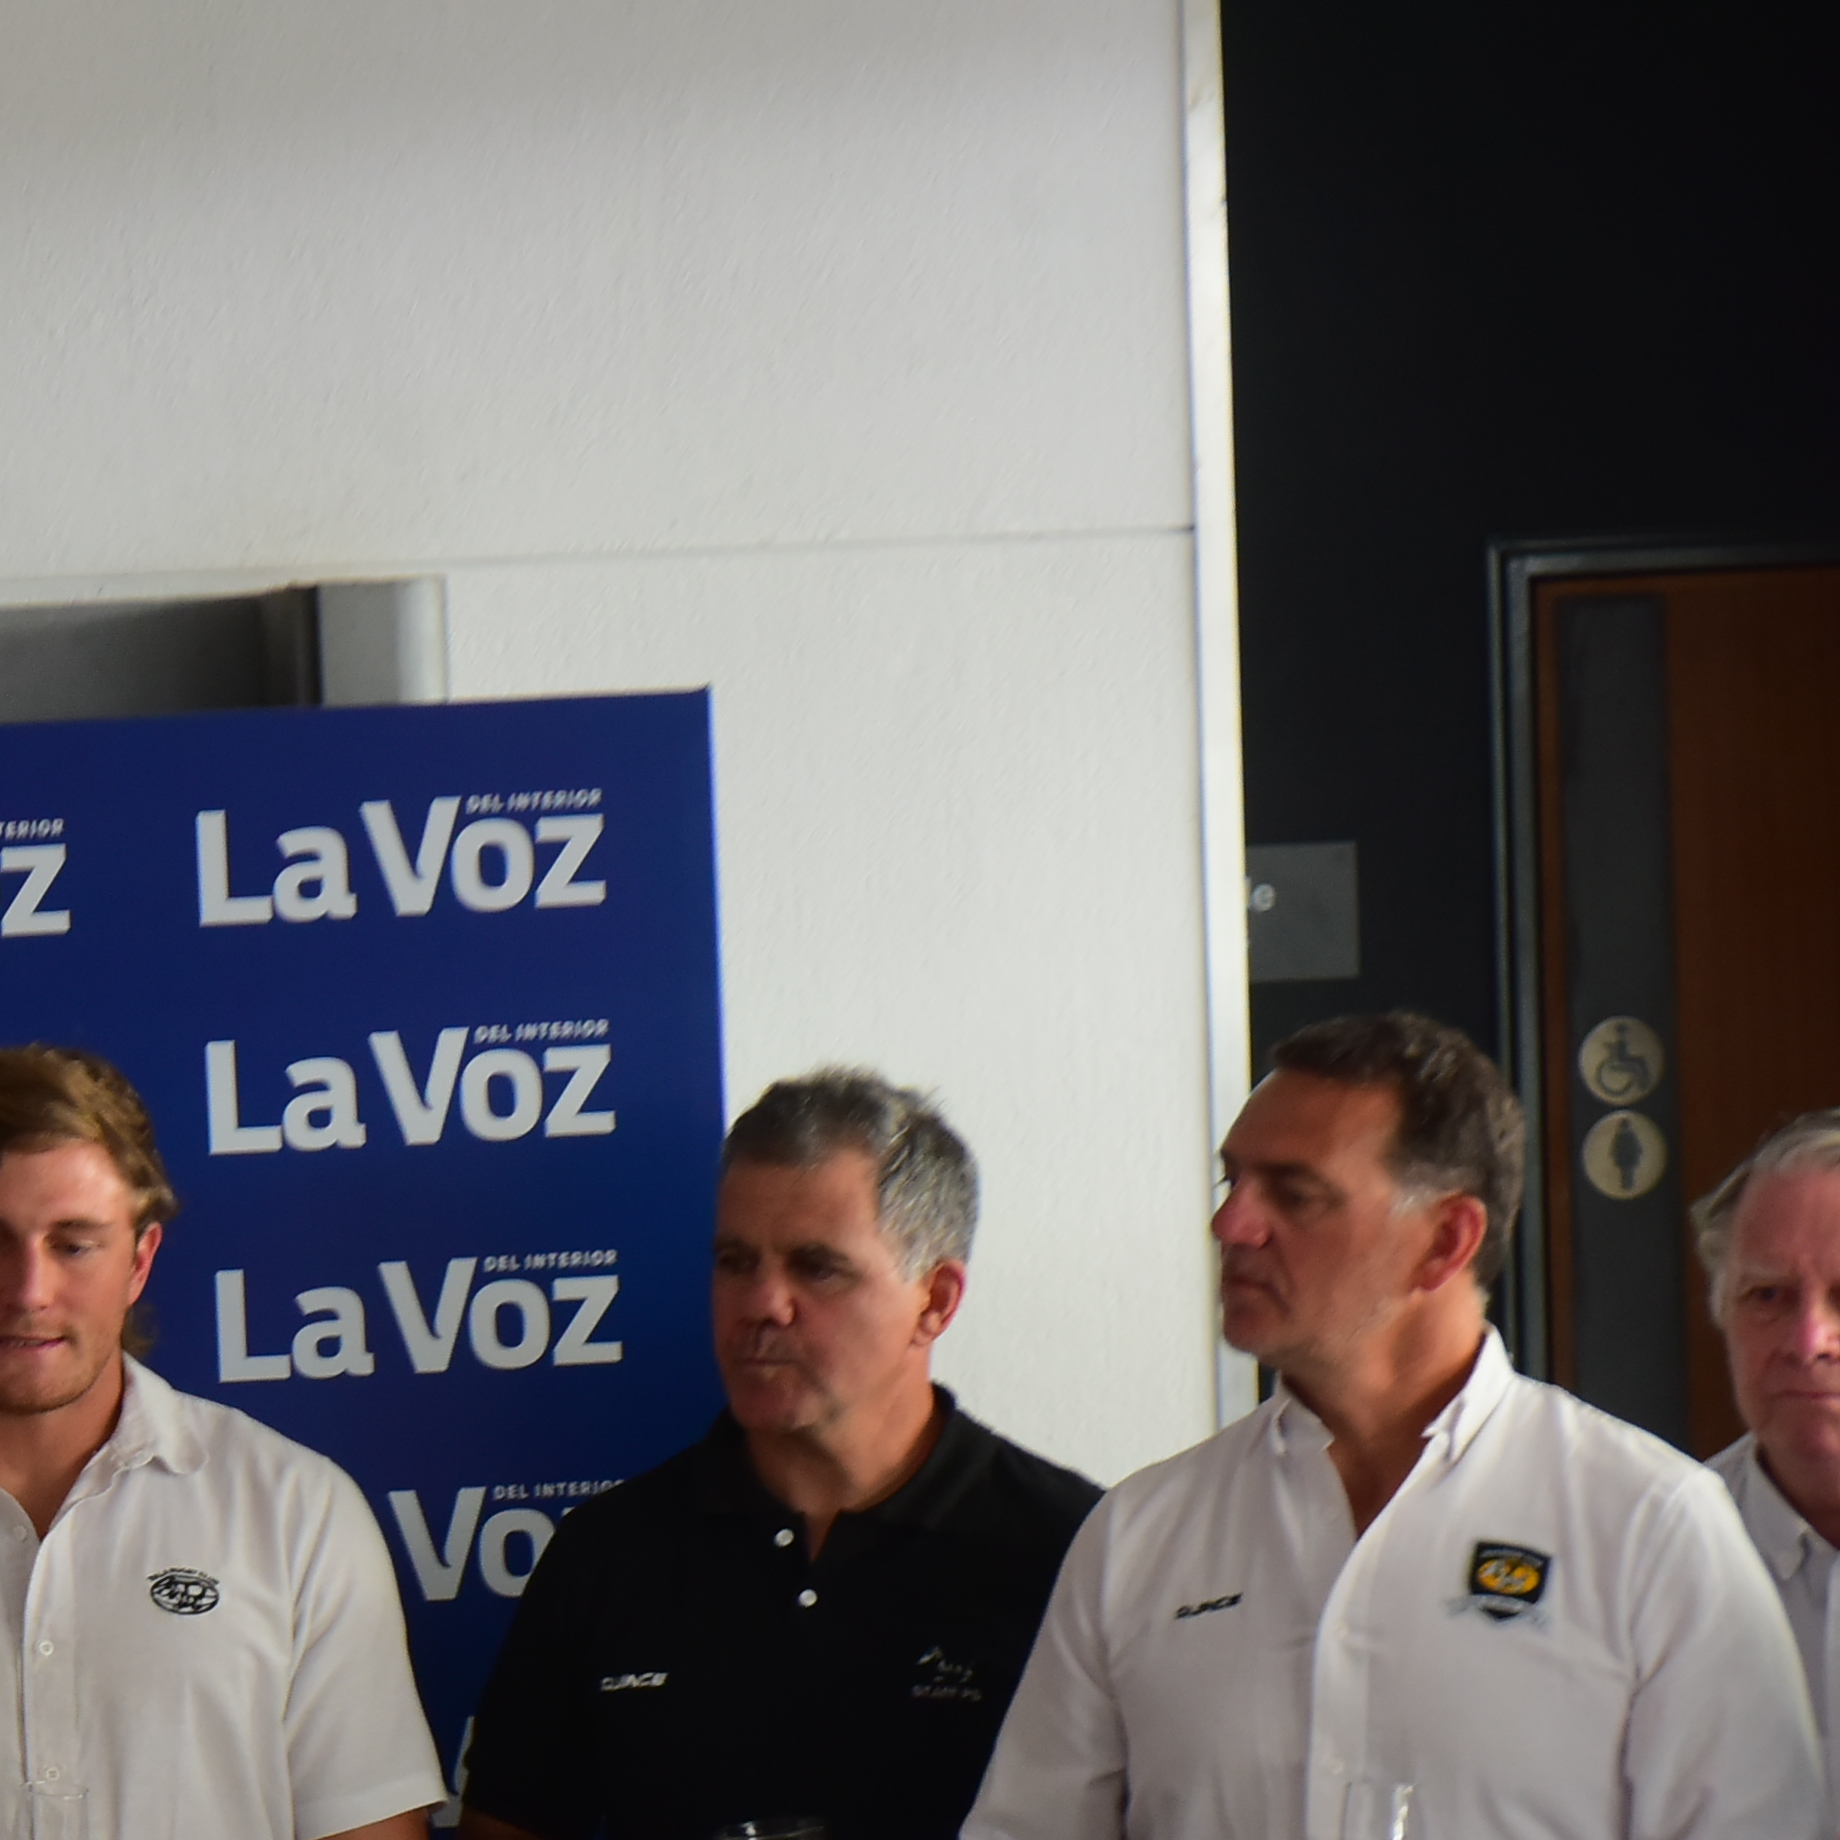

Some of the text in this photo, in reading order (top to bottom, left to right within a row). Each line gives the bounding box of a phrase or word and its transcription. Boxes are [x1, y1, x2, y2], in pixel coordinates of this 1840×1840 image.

[467, 789, 601, 812] DEL INTERIOR
[475, 1020, 608, 1042] DEL INTERIOR
[485, 1250, 616, 1271] DEL INTERIOR
[492, 1484, 529, 1500] DEL
